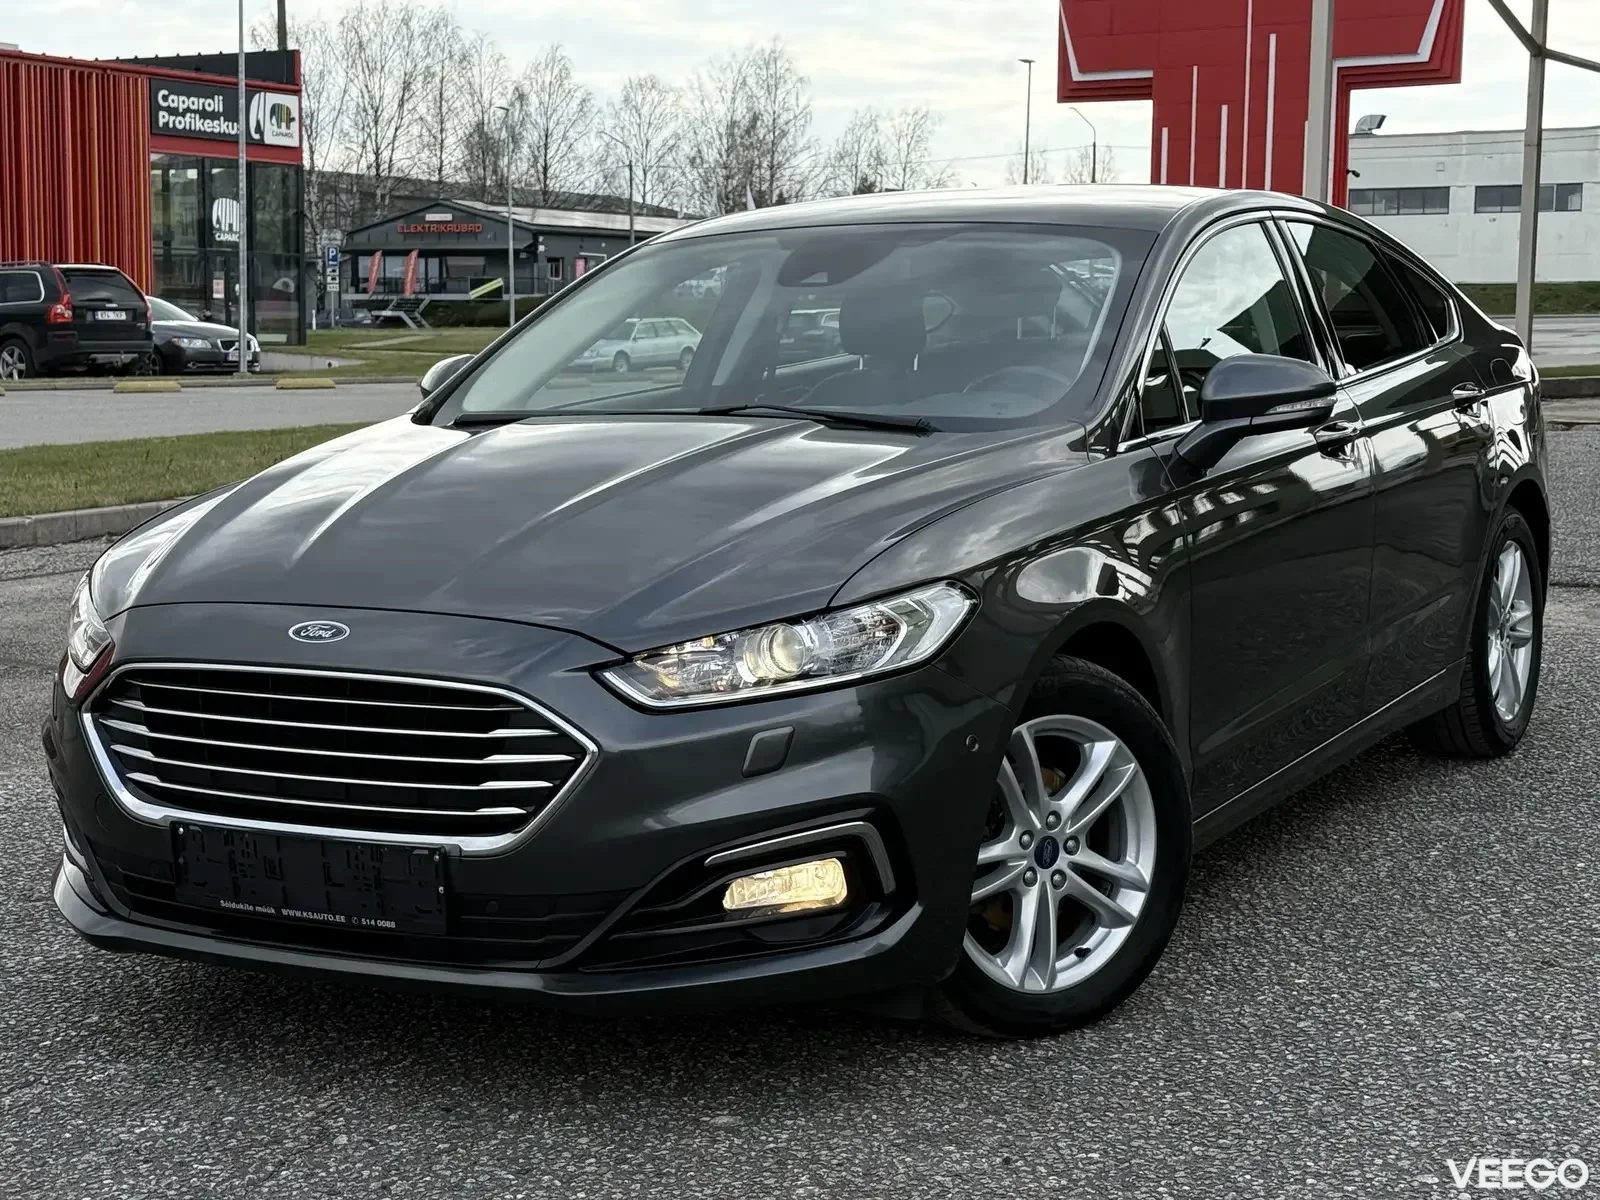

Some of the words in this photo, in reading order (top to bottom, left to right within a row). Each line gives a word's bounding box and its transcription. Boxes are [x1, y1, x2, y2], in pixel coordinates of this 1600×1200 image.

[157, 89, 224, 113] Caparoli
[397, 223, 482, 233] ELEKTRIKAUBAD
[329, 247, 337, 259] P
[300, 624, 337, 637] Ford
[281, 908, 346, 923] WWW.KSAUTO.EE
[361, 918, 376, 926] 514
